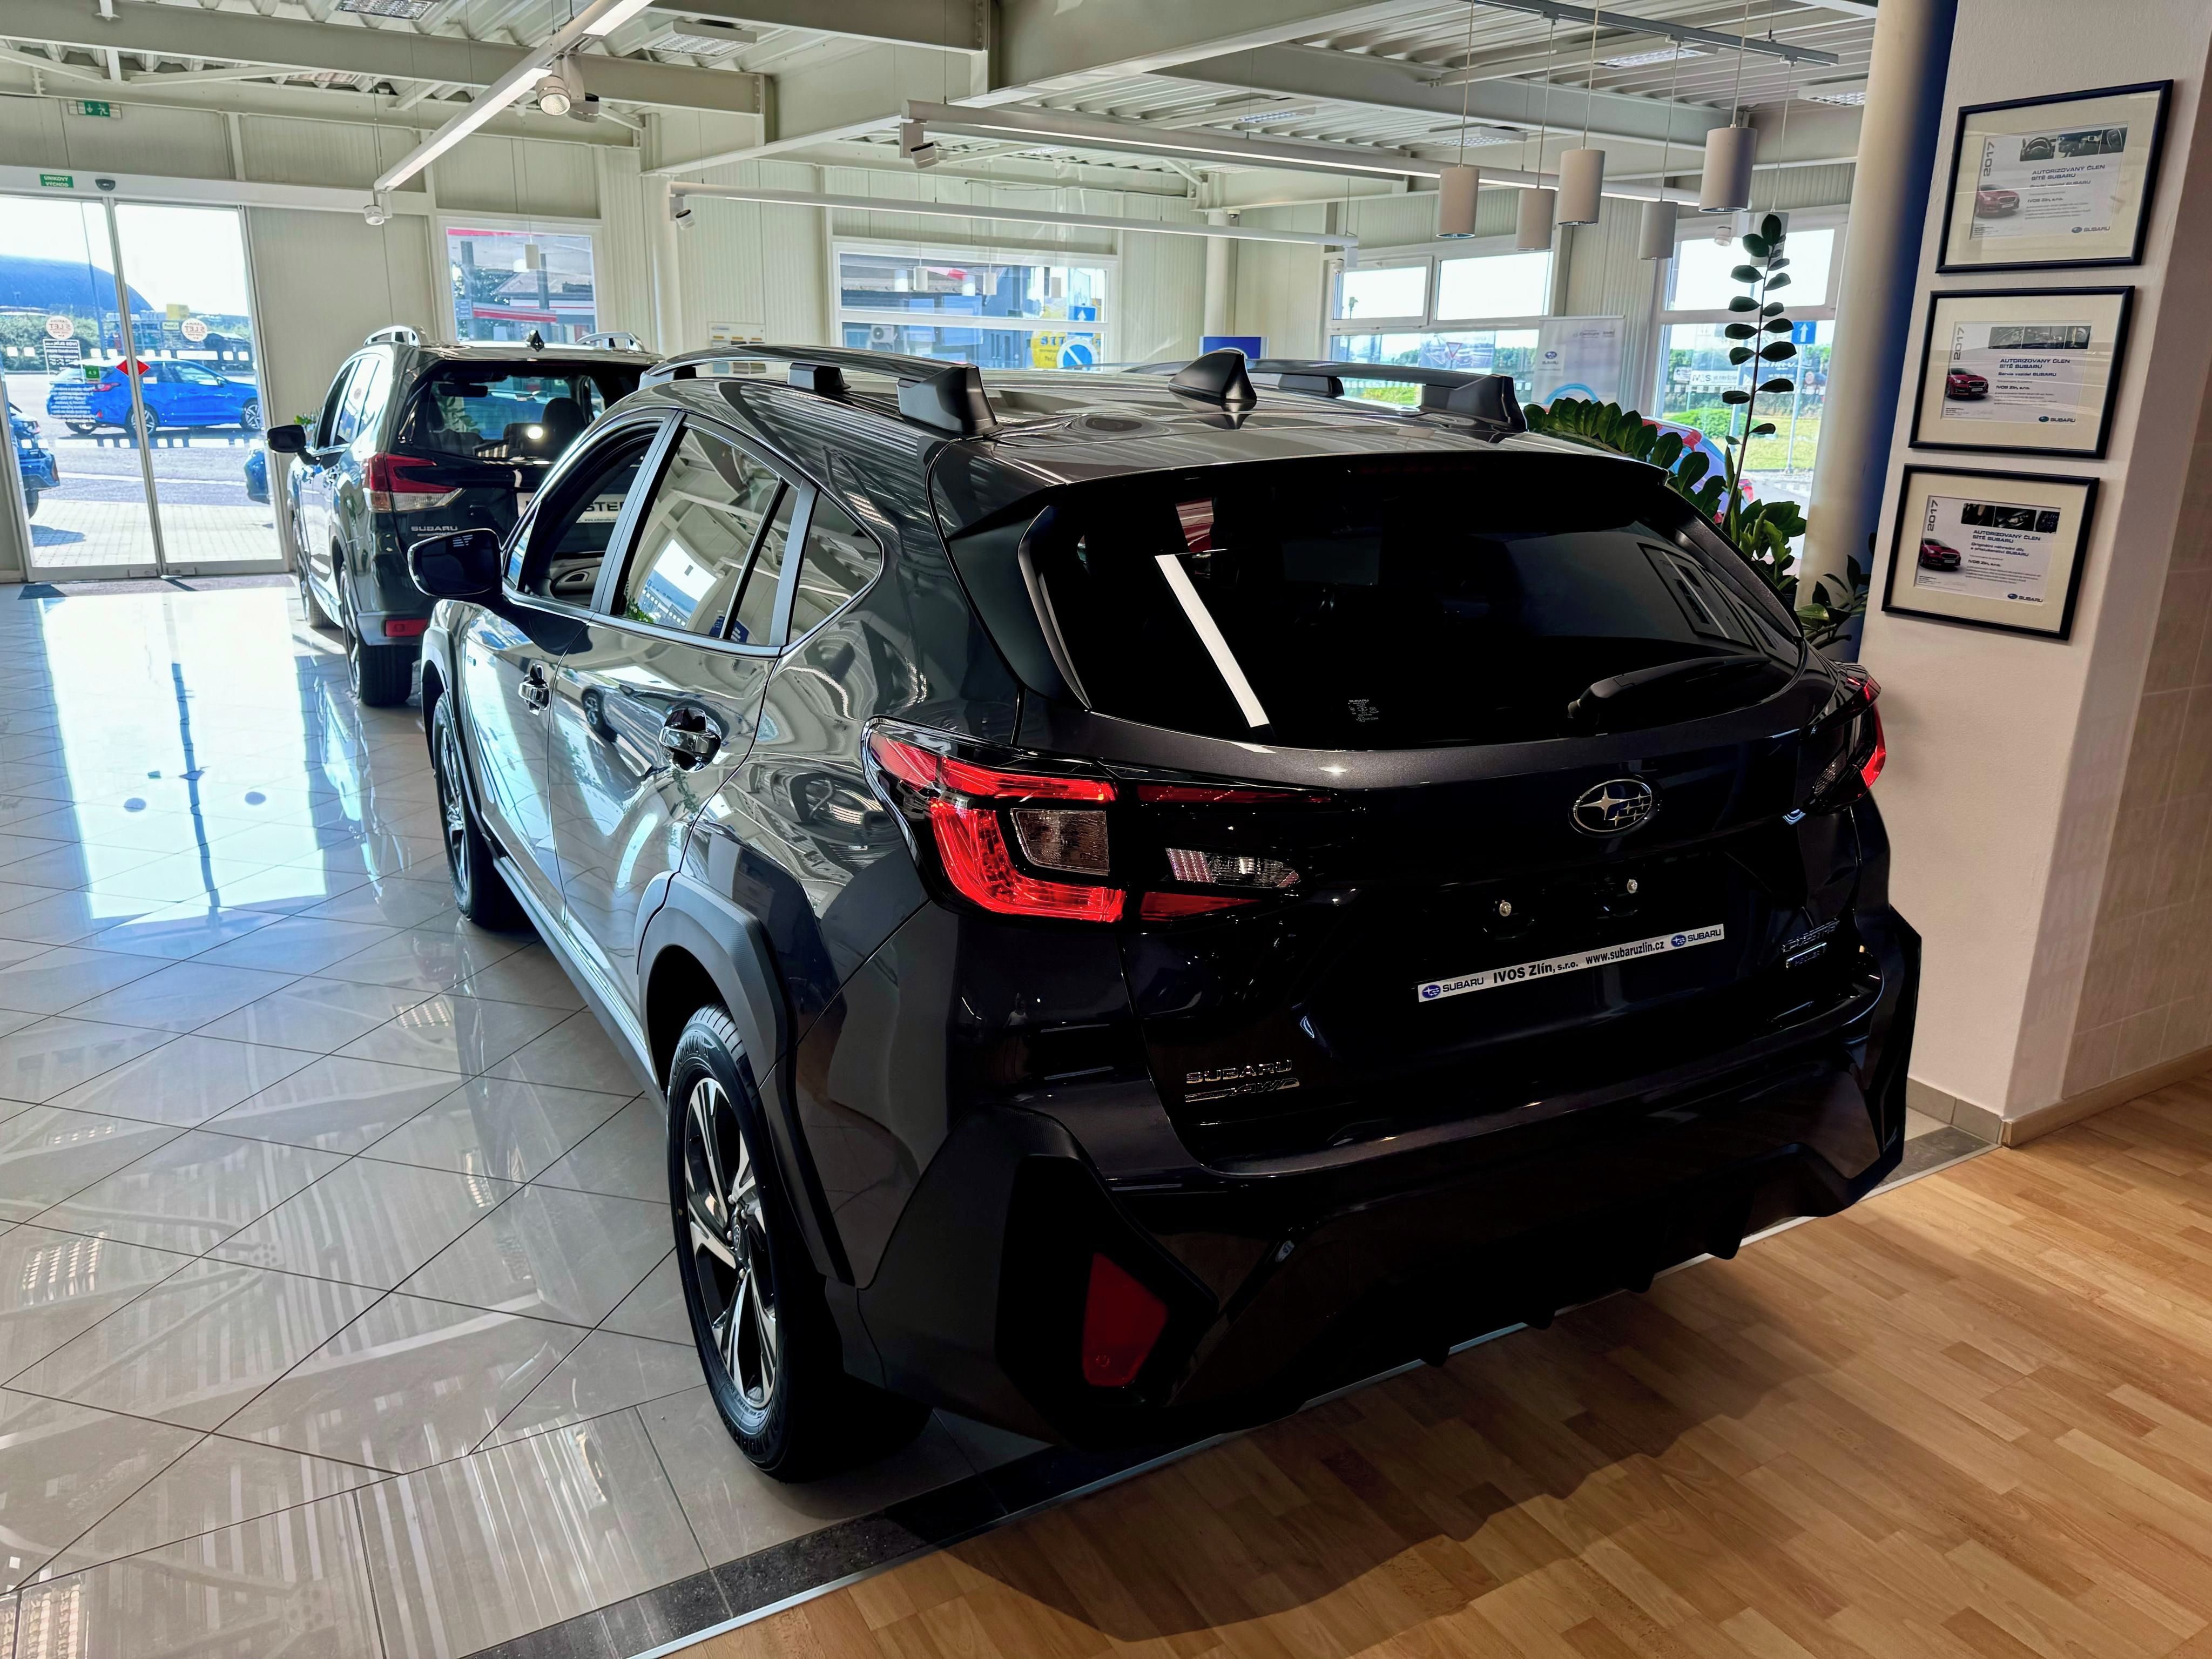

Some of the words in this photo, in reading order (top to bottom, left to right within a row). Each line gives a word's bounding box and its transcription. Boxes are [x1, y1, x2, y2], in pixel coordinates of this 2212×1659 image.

[1984, 142, 1995, 177] 2017
[2032, 166, 2085, 175] AUTORIZOVANÝ
[1953, 327, 1965, 361] 2017
[1926, 500, 1939, 532] 2017
[1973, 530, 2022, 539] AUTORIZOVANÝ
[1442, 976, 1484, 993] SUBARU
[1493, 966, 1526, 984] IVOS
[1528, 962, 1556, 976] Zlín,
[1557, 960, 1579, 971] s.r.o.
[1585, 940, 1665, 965] www.subaruzlin.cz
[1687, 928, 1722, 942] SUBARU
[1186, 1059, 1292, 1084] SUBARU
